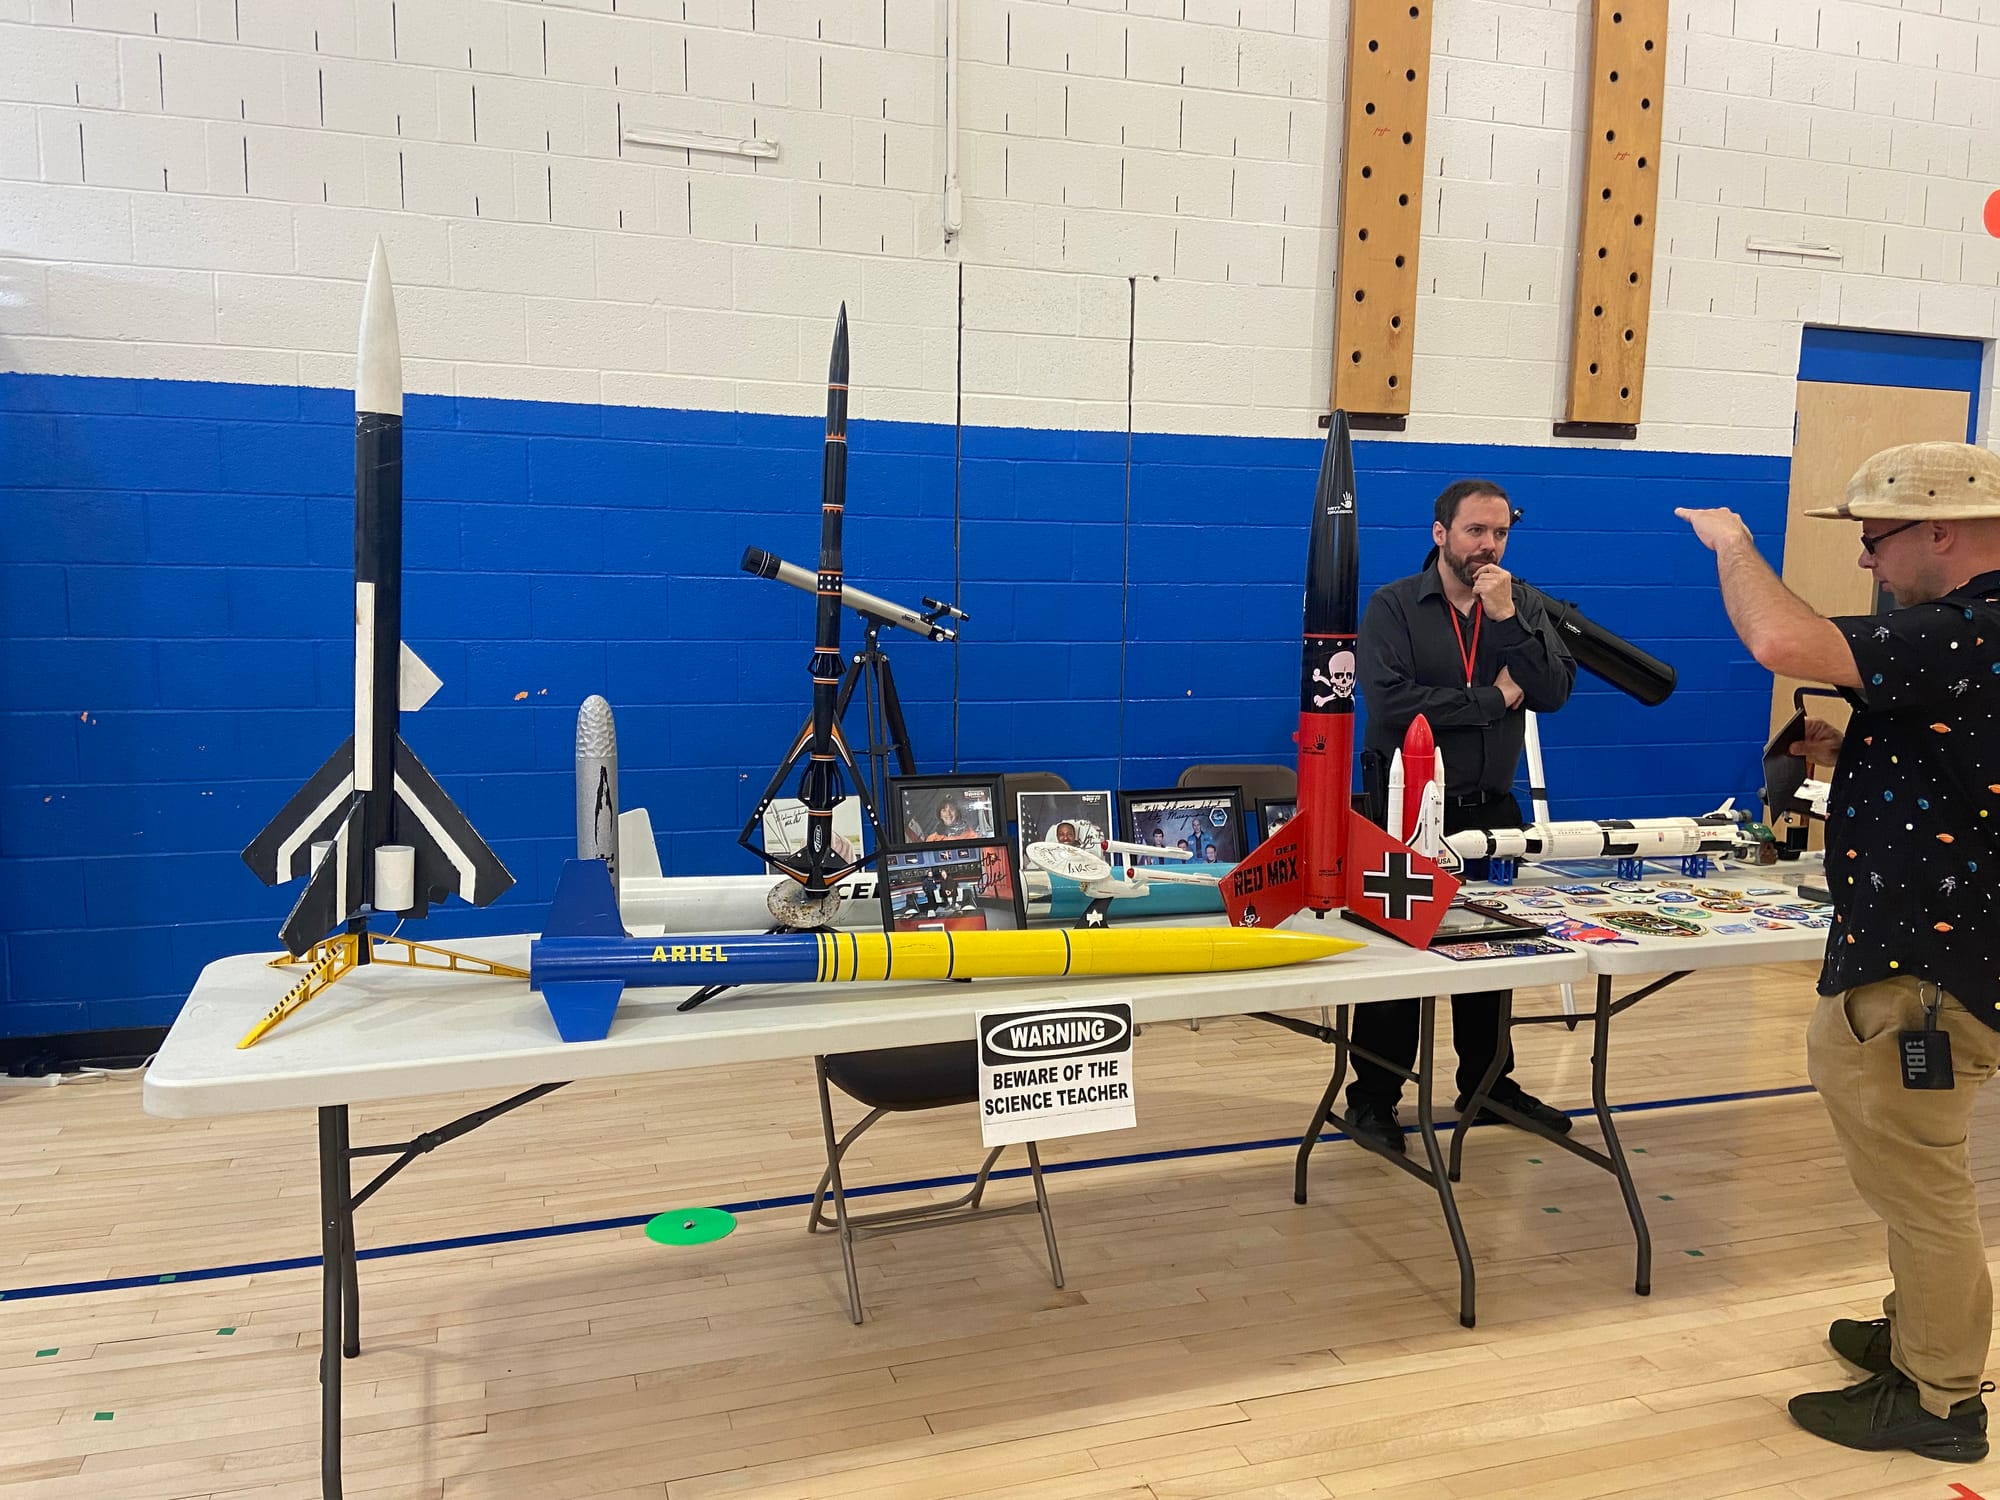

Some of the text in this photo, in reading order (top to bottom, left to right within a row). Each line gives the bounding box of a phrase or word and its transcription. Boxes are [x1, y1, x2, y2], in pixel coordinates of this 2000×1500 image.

[1275, 843, 1297, 856] DER
[1437, 857, 1451, 865] USA
[837, 883, 880, 899] CE
[1233, 856, 1299, 897] RED MAX
[651, 945, 728, 962] ARIEL
[1010, 1020, 1106, 1049] WARNING
[1905, 1040, 1927, 1080] JBL
[993, 1060, 1118, 1090] BEWARE OF THE
[985, 1083, 1129, 1116] SCIENCE TEACHER
